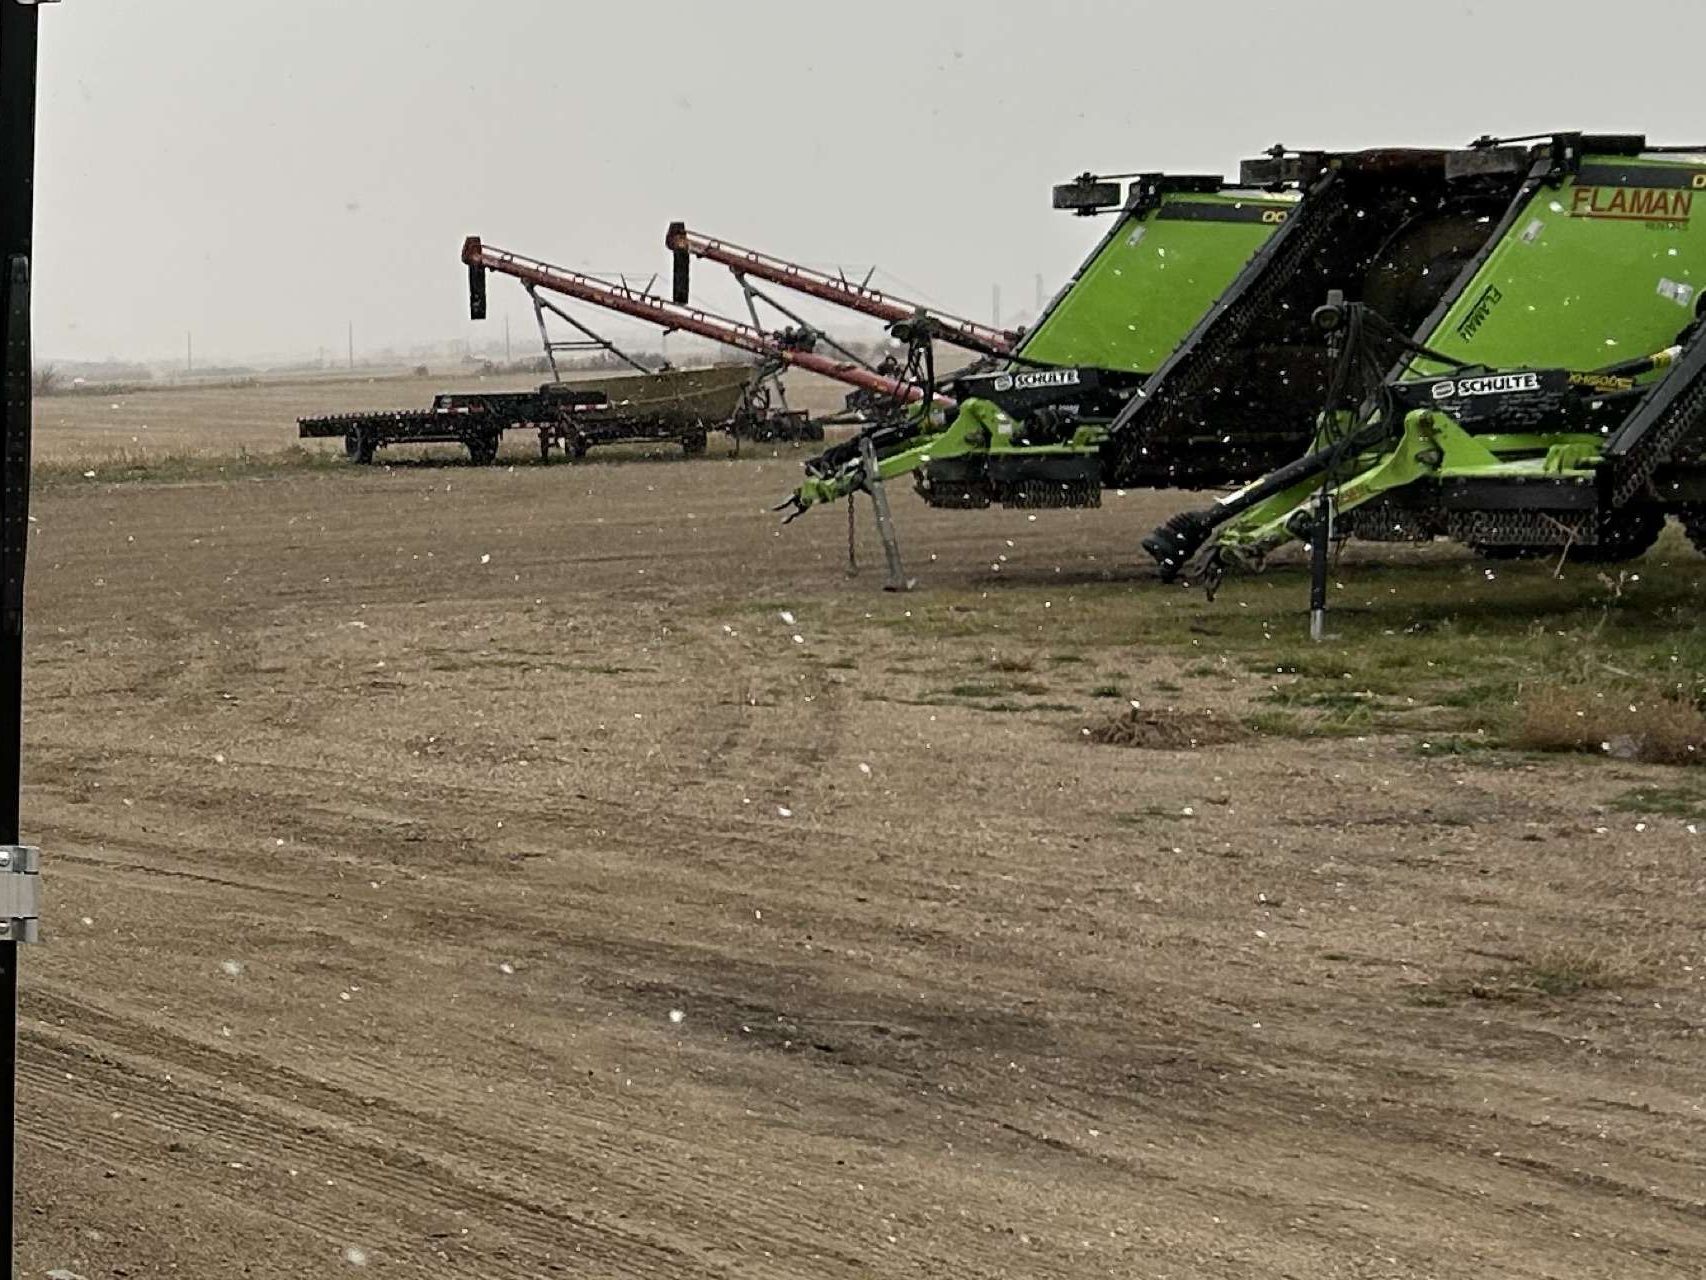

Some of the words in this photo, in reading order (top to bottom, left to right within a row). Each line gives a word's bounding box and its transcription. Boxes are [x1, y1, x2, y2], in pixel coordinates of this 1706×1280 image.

[1571, 187, 1693, 216] FLAMAN
[1017, 371, 1078, 387] SCHULTE
[1459, 373, 1535, 393] SCHULTE
